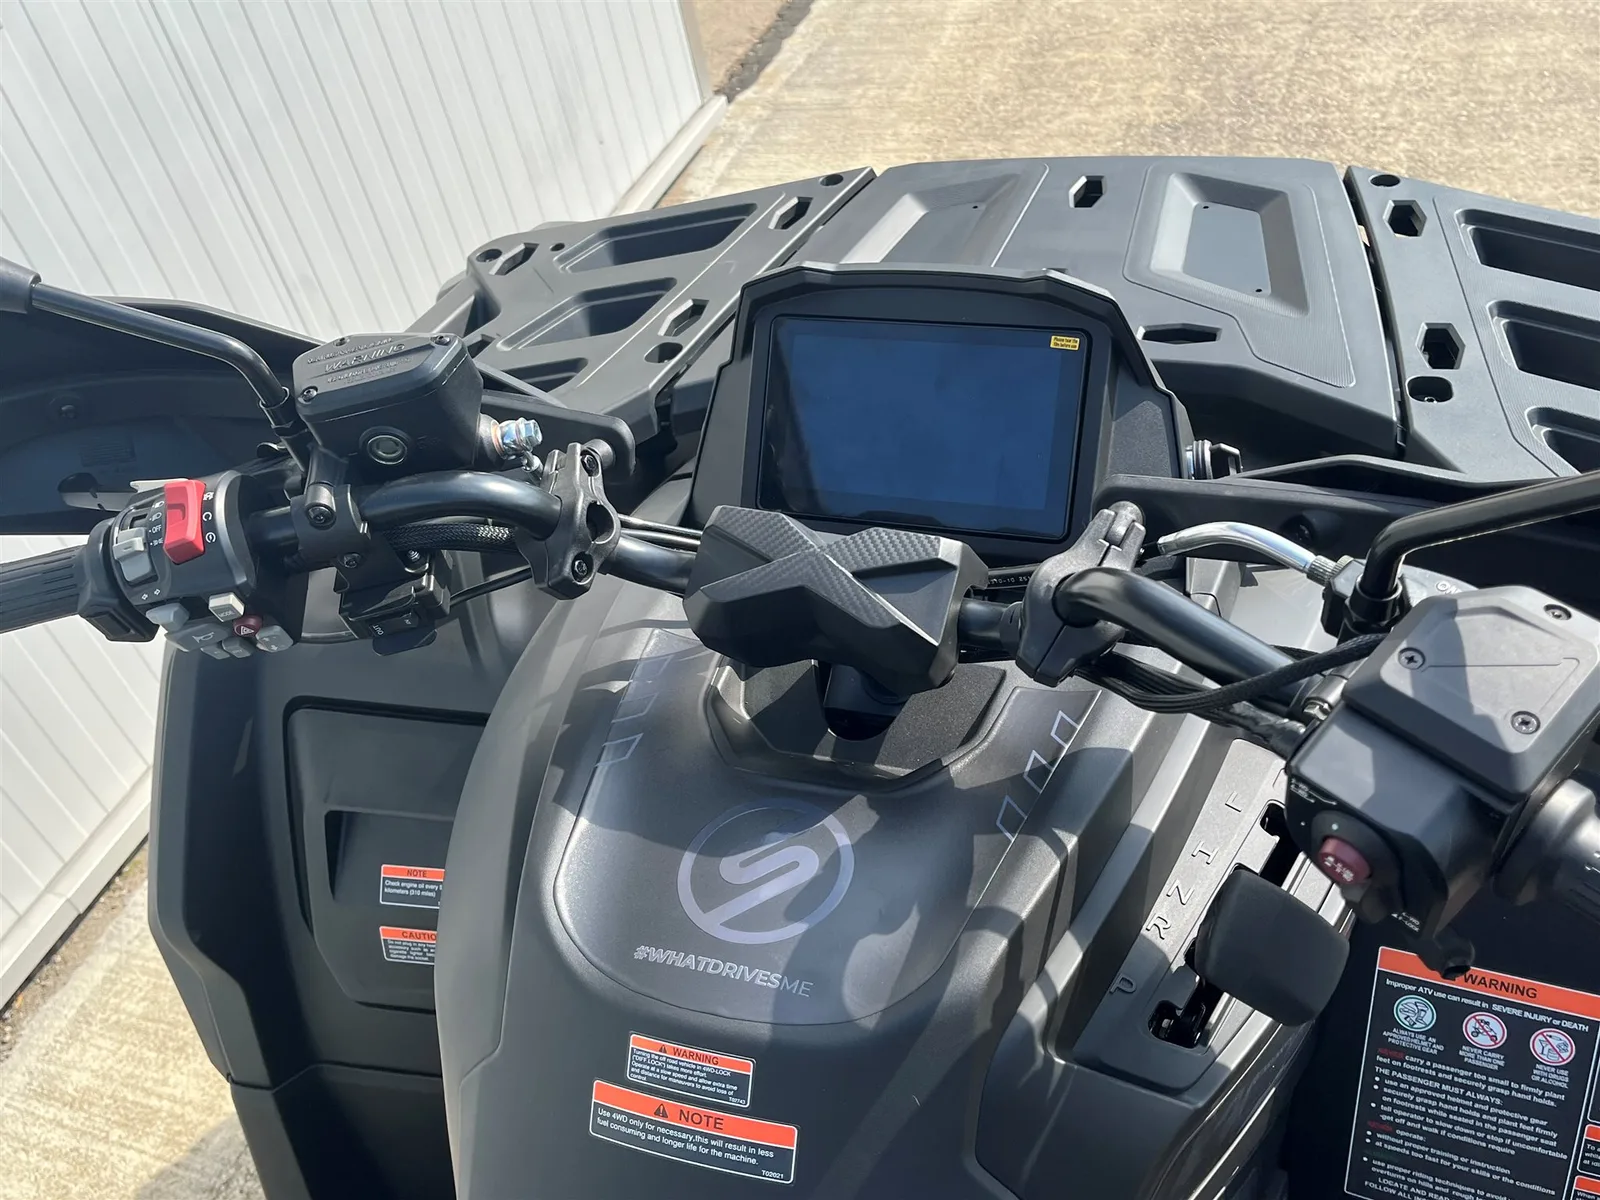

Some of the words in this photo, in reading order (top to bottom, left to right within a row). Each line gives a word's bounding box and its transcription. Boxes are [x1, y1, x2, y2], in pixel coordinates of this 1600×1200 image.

[325, 344, 405, 372] WARNING
[152, 524, 162, 533] OFF
[407, 869, 427, 877] NOTE
[402, 931, 437, 941] CAUTIO
[1146, 912, 1172, 940] R
[633, 945, 815, 998] #WHATDRIVESME
[1109, 972, 1137, 994] P
[1463, 972, 1538, 1000] WARNING
[1386, 978, 1417, 993] Improper
[1417, 986, 1433, 995] ATV
[1434, 991, 1446, 999] use
[1447, 994, 1460, 1002] can
[1461, 996, 1481, 1007] result
[1482, 1001, 1489, 1009] in
[1492, 1003, 1523, 1017] SEVERE
[1523, 1011, 1552, 1024] INJURY
[1561, 1020, 1589, 1032] DEATH
[672, 1047, 719, 1066] WARNING
[1375, 1066, 1390, 1076] THE
[1392, 1070, 1441, 1089] PASSENGER
[1442, 1083, 1465, 1095] MUST
[1466, 1090, 1504, 1106] ALWAYS:
[1376, 1055, 1390, 1064] feet
[1403, 1062, 1437, 1076] footrests
[1437, 1071, 1452, 1080] and
[1453, 1075, 1486, 1090] securely
[1487, 1085, 1510, 1096] grasp
[1511, 1090, 1532, 1101] hand
[1532, 1096, 1558, 1107] holds.
[1405, 1055, 1424, 1066] carry
[1432, 1062, 1471, 1078] passenger
[1473, 1072, 1487, 1081] too
[1488, 1076, 1509, 1087] small
[1520, 1084, 1544, 1096] firmly
[1544, 1090, 1565, 1102] plant
[678, 1108, 724, 1131] NOTE
[1383, 1087, 1415, 1101] securely
[1415, 1096, 1437, 1107] grasp
[1438, 1101, 1458, 1112] hand
[1459, 1107, 1481, 1118] holds
[1482, 1113, 1497, 1122] and
[1498, 1117, 1518, 1129] plant
[1519, 1122, 1535, 1132] feet
[1535, 1127, 1558, 1139] firmly
[1384, 1079, 1398, 1087] use
[1410, 1085, 1446, 1100] approved
[1447, 1095, 1473, 1107] helmet
[1474, 1102, 1489, 1111] and
[1490, 1106, 1529, 1122] protective
[1529, 1117, 1548, 1127] gear
[1393, 1098, 1426, 1112] footrests
[1427, 1107, 1448, 1118] while
[1449, 1113, 1474, 1125] seated
[1484, 1122, 1498, 1131] the
[1498, 1127, 1539, 1143] passenger
[1540, 1138, 1557, 1147] seat
[597, 1116, 609, 1127] fuel
[609, 1122, 646, 1140] consuming
[647, 1133, 661, 1143] and
[662, 1136, 685, 1151] longer
[686, 1142, 697, 1152] life
[698, 1145, 710, 1155] for
[710, 1148, 723, 1158] the
[724, 1150, 759, 1166] machine.
[598, 1107, 611, 1118] Use
[611, 1112, 628, 1123] 4WD
[628, 1118, 644, 1130] only
[645, 1122, 655, 1131] for
[710, 1138, 724, 1148] will
[725, 1140, 747, 1153] result
[748, 1146, 756, 1155] in
[757, 1148, 774, 1159] less
[1380, 1105, 1392, 1113] tell
[1393, 1109, 1425, 1122] operator
[1435, 1119, 1454, 1129] slow
[1454, 1124, 1475, 1135] down
[1486, 1133, 1504, 1144] stop
[1512, 1140, 1568, 1160] uncomfortable
[1395, 1129, 1426, 1142] operate:
[1395, 1117, 1405, 1126] off
[1406, 1120, 1421, 1130] and
[1422, 1125, 1439, 1135] walk
[1447, 1131, 1487, 1147] conditions
[1488, 1143, 1516, 1156] require
[1376, 1133, 1404, 1145] without
[1404, 1141, 1429, 1153] proper
[1430, 1147, 1459, 1161] training
[1470, 1158, 1511, 1174] instruction
[1383, 1143, 1410, 1156] speeds
[1411, 1151, 1424, 1160] too
[1424, 1154, 1439, 1164] fast
[1440, 1159, 1451, 1167] for
[1452, 1163, 1470, 1173] your
[1471, 1167, 1491, 1178] skills
[1502, 1176, 1515, 1184] the
[1515, 1179, 1556, 1196] conditions
[761, 1168, 784, 1181] T02021
[1365, 1181, 1396, 1195] FOLLOW
[1397, 1190, 1412, 1200] ALL
[1377, 1177, 1409, 1191] LOCATE
[1410, 1186, 1428, 1196] AND
